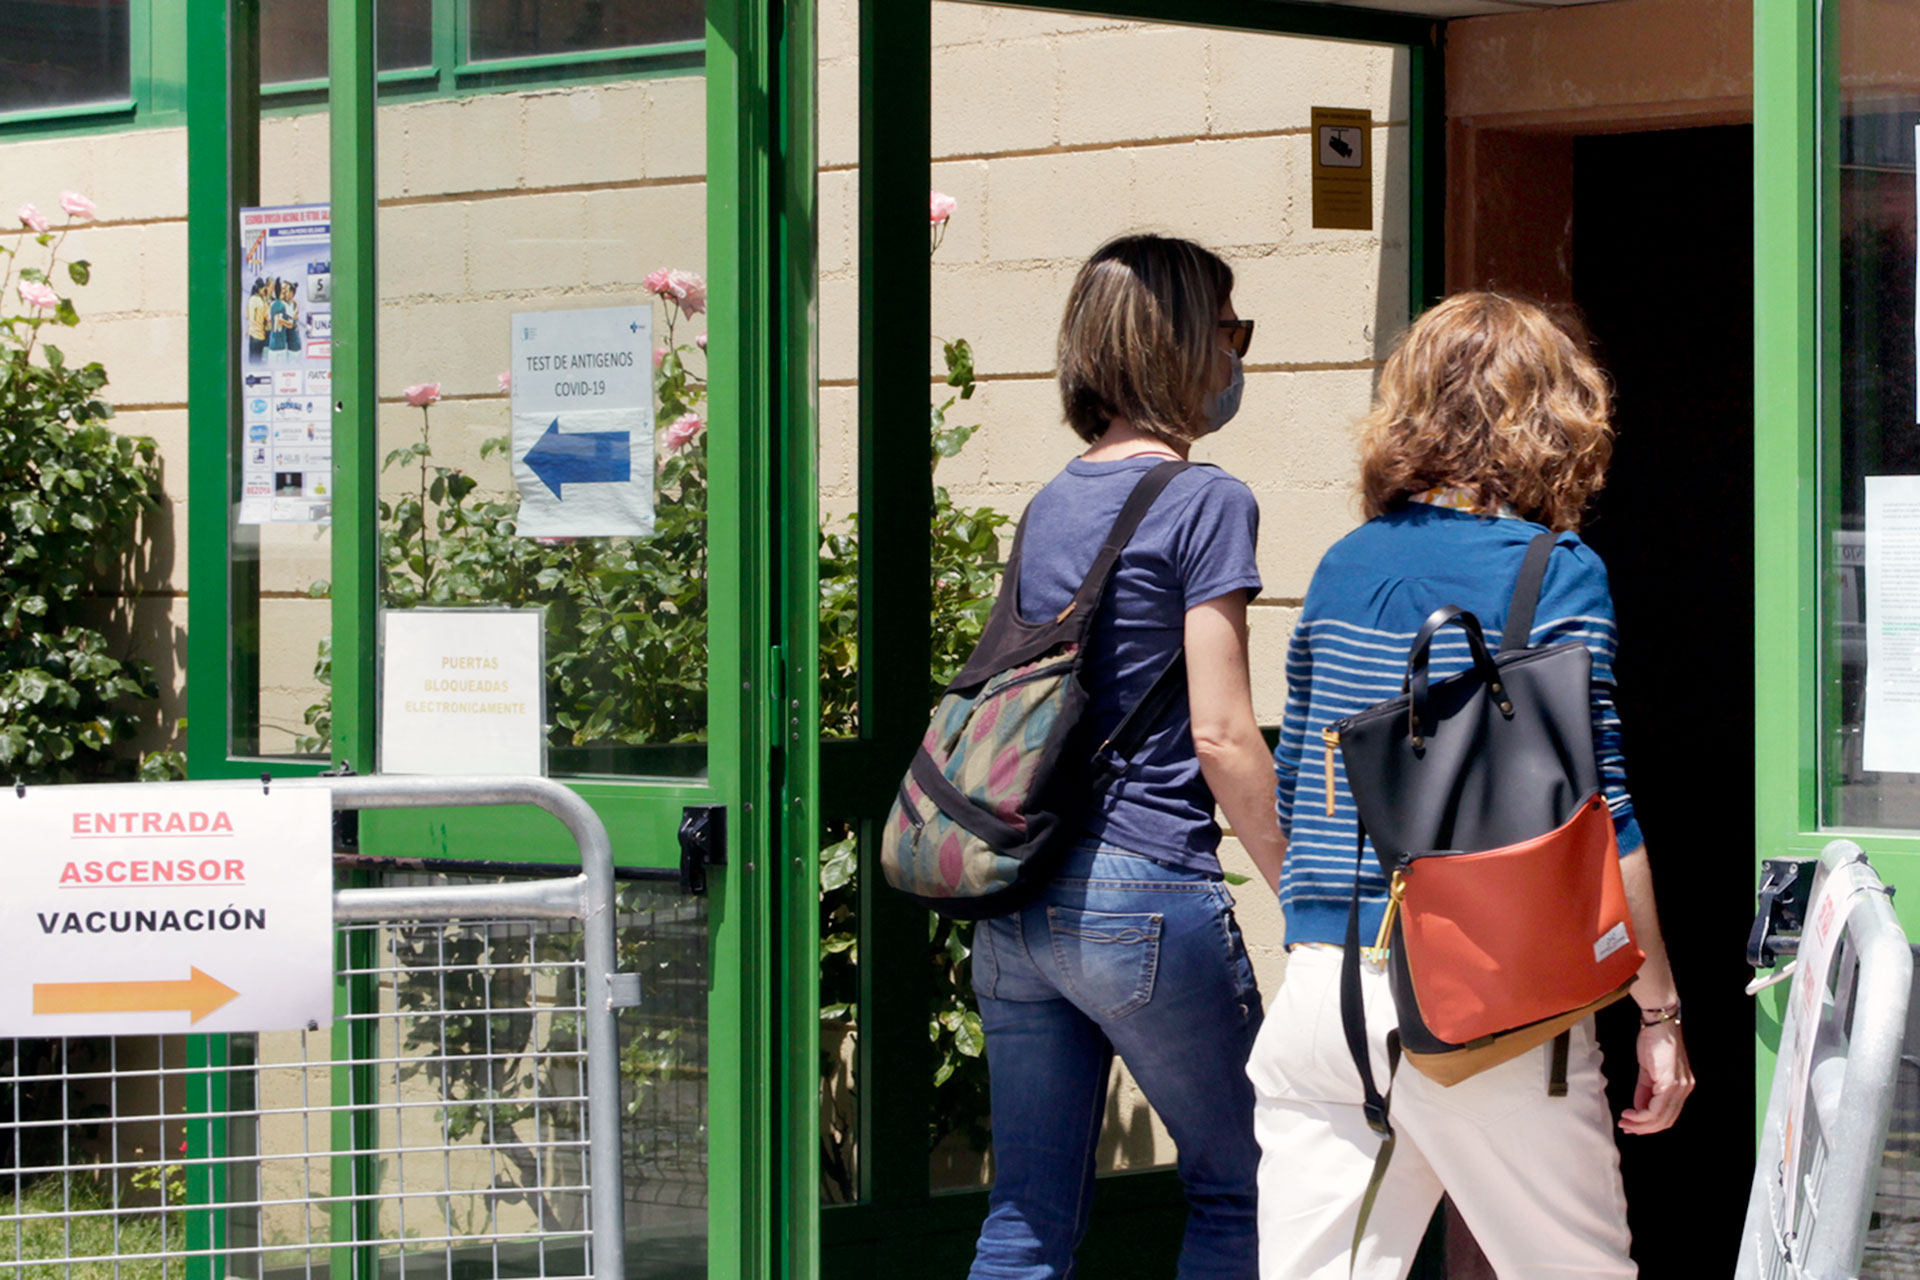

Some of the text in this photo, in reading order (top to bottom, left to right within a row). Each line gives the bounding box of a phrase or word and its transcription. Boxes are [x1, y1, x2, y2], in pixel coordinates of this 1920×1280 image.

[317, 279, 323, 291] 5
[526, 352, 633, 371] TEST DE ANTIGENOS
[555, 380, 605, 397] COVID-19
[442, 656, 498, 669] PUERTAS
[425, 679, 509, 693] BLOQUEADAS
[73, 811, 234, 834] ENTRADA
[59, 859, 245, 884] ASCENSOR
[37, 904, 266, 934] VACUNACIÓN
